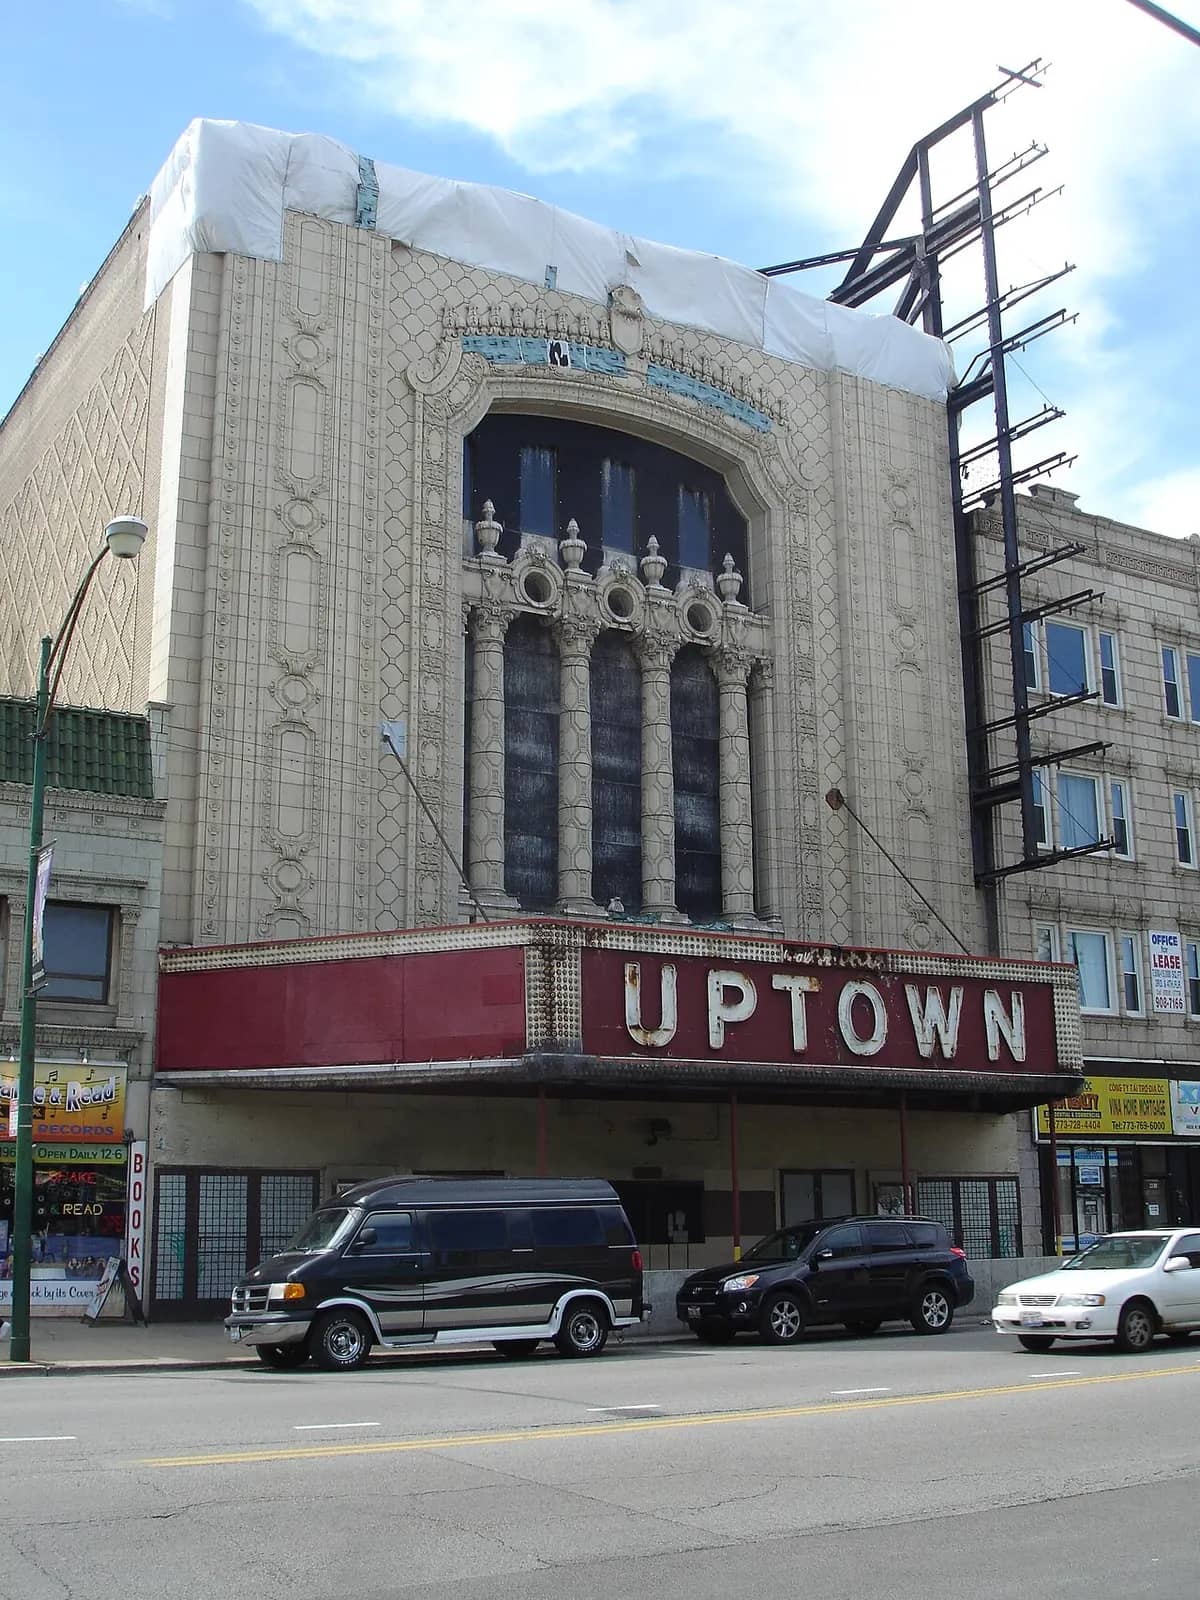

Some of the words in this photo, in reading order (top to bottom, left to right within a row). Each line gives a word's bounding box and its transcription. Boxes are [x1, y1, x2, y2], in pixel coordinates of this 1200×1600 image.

[1151, 934, 1178, 946] OFFICE
[1153, 954, 1180, 969] LEASE
[624, 961, 1027, 1063] UPTOWN
[49, 1088, 61, 1105] &
[66, 1075, 116, 1112] Read
[37, 1124, 113, 1135] RECORDS
[101, 1148, 123, 1159] 12-6
[63, 1203, 103, 1216] READ
[131, 1153, 143, 1287] BOOKS
[69, 1286, 95, 1298] Cover
